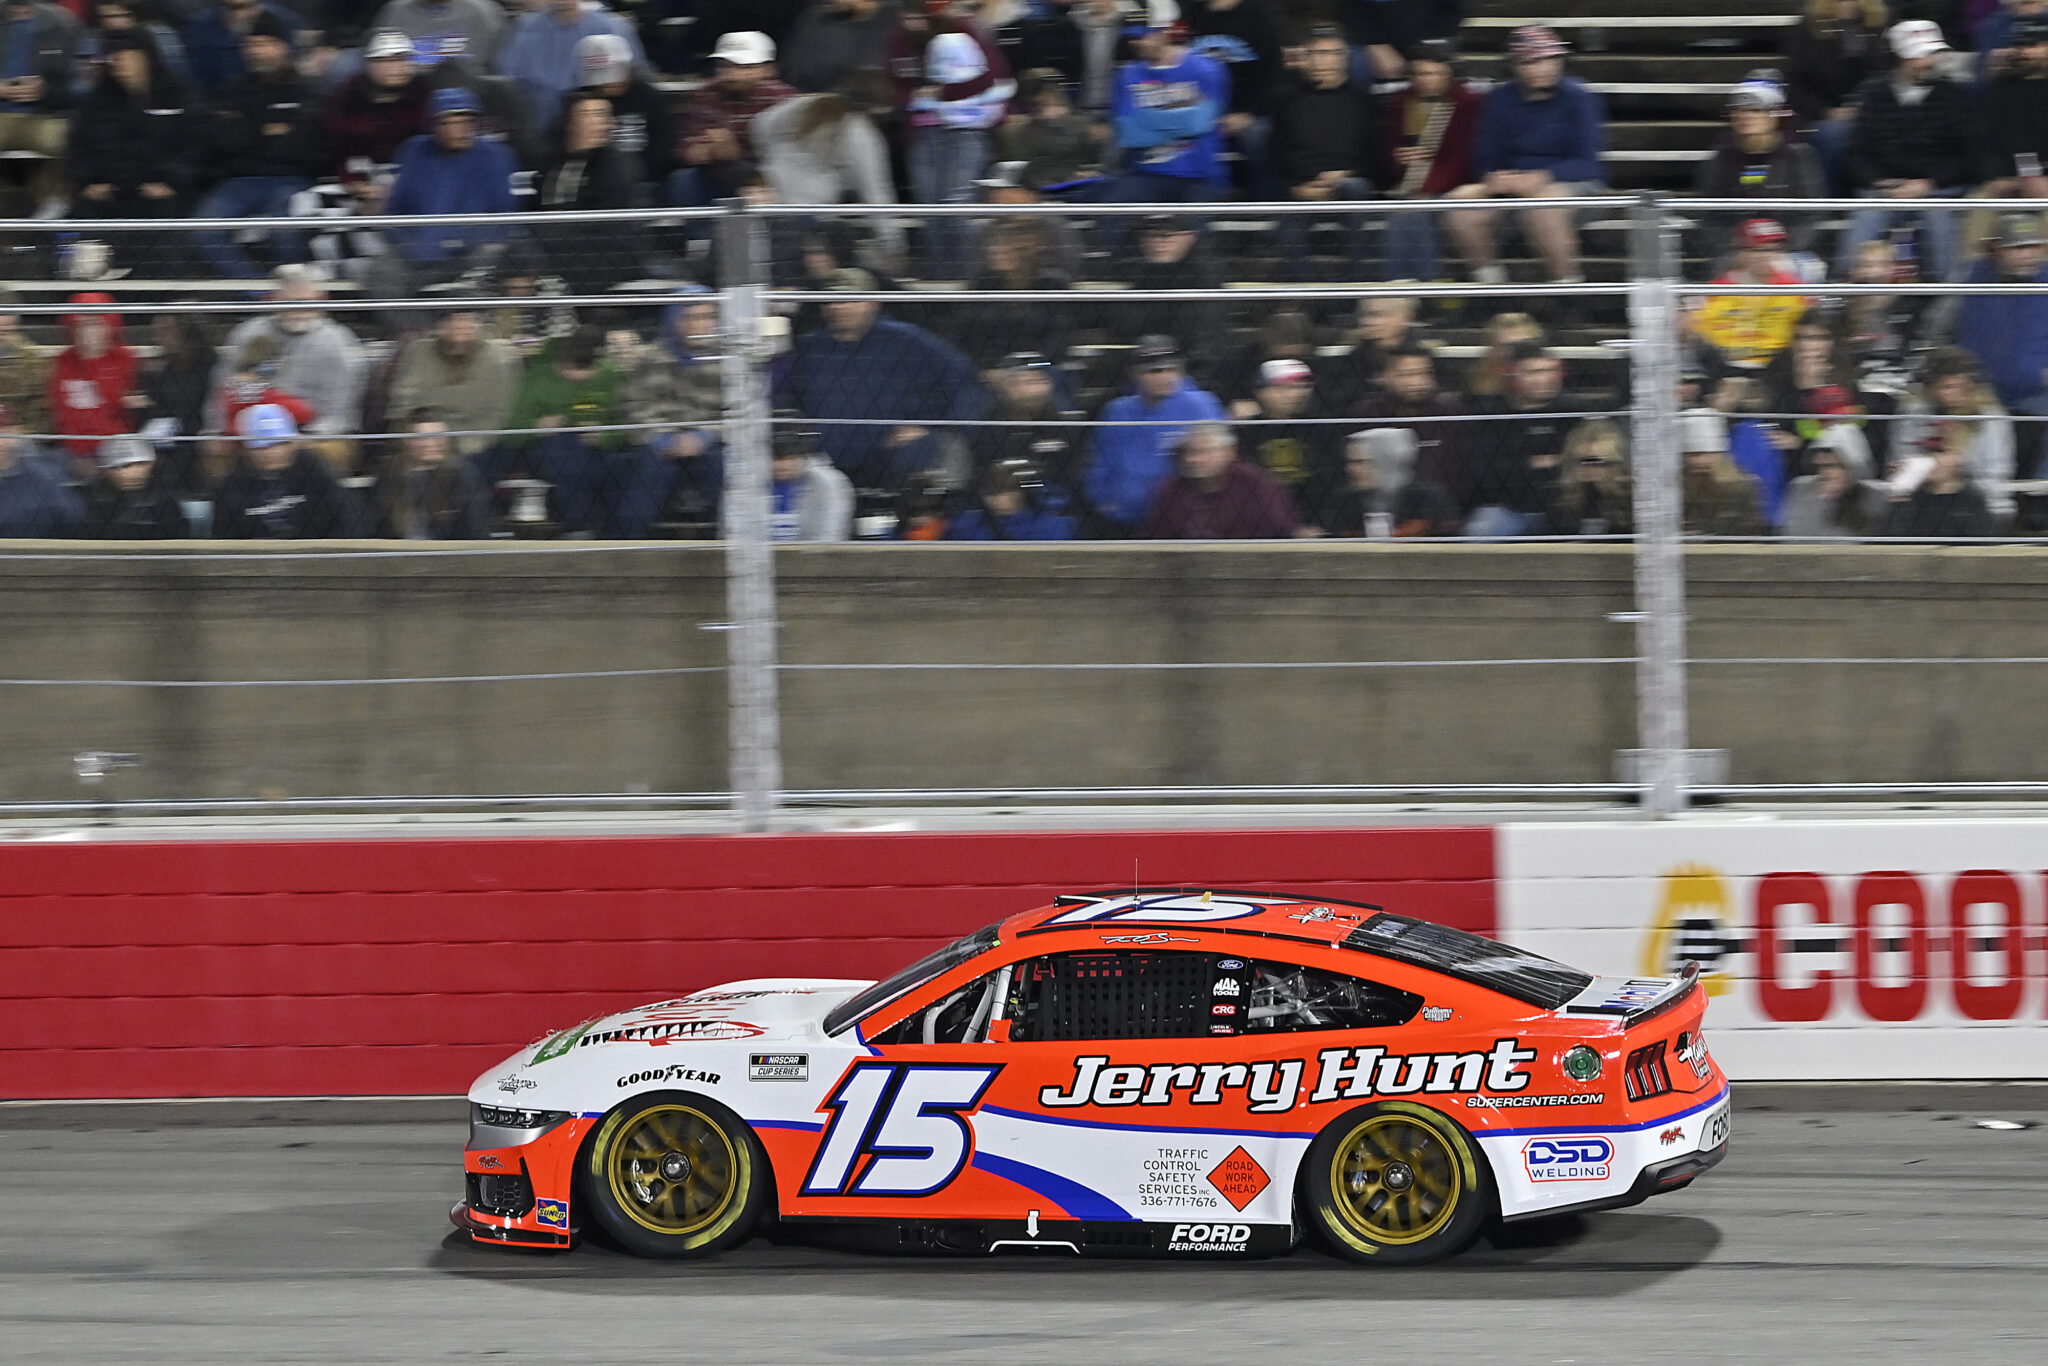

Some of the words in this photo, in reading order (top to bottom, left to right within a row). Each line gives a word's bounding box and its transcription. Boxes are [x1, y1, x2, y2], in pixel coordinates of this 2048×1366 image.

[1754, 869, 2048, 1022] COO
[1212, 977, 1240, 991] MAC
[1212, 1004, 1235, 1014] CRC
[767, 1056, 800, 1065] NASCAR
[757, 1067, 773, 1076] CUP
[774, 1067, 800, 1076] SERIES
[1040, 1056, 1304, 1112] Jerry
[1311, 1039, 1536, 1102] Hunt
[1467, 1094, 1604, 1108] SUPERCENTER.COM
[799, 1062, 1005, 1197] 15
[1157, 1148, 1209, 1160] TRAFFIC
[1528, 1139, 1611, 1165] DSD
[1143, 1160, 1201, 1172] CONTROL
[1226, 1160, 1254, 1171] ROAD
[1149, 1172, 1196, 1183] SAFETY
[1225, 1172, 1255, 1182] WORK
[1531, 1166, 1606, 1179] WELDING
[1138, 1183, 1198, 1195] SERVICES
[1198, 1188, 1210, 1196] INC
[1222, 1183, 1257, 1194] AHEAD
[1140, 1195, 1218, 1208] 336-771-7676
[1171, 1224, 1251, 1243] FORD
[1168, 1242, 1247, 1252] PERFORMANCE
